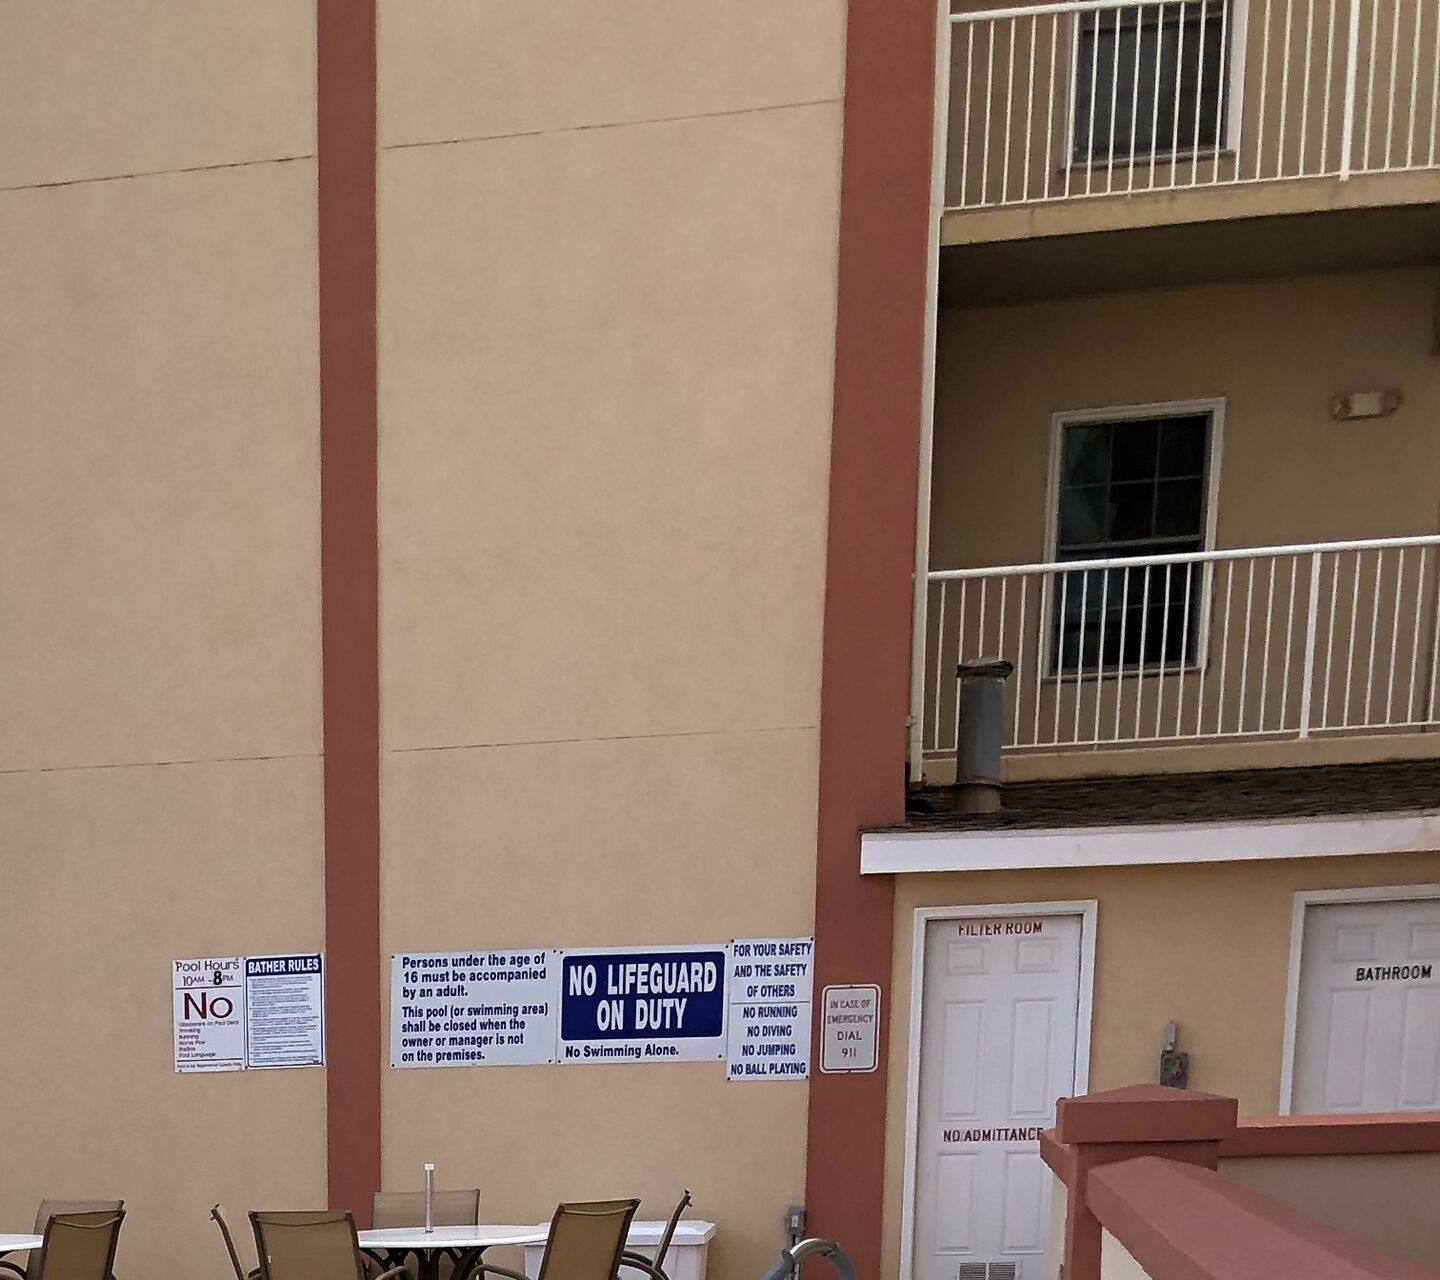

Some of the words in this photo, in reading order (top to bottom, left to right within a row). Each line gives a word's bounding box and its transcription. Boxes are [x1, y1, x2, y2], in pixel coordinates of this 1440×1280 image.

[1005, 921, 1043, 935] ROOM
[733, 944, 751, 957] FOR
[753, 943, 777, 957] YOUR
[779, 942, 812, 956] SAFETY
[175, 960, 201, 972] Pool
[204, 960, 240, 971] Hours
[248, 959, 286, 974] BATHER
[288, 958, 319, 972] RULES
[402, 956, 449, 969] Persons
[451, 953, 485, 968] under
[488, 953, 507, 966] the
[509, 955, 531, 968] age
[533, 951, 546, 965] of
[403, 970, 419, 984] 16
[421, 970, 450, 983] must
[452, 969, 467, 982] be
[469, 967, 547, 983] accompanied
[733, 964, 753, 978] AND
[755, 964, 772, 977] THE
[773, 963, 808, 977] SAFETY
[1355, 964, 1433, 982] BATHROOM
[569, 964, 597, 996] NO
[607, 961, 717, 995] LIFEGUARD
[402, 985, 417, 1001] by
[419, 988, 433, 998] an
[435, 984, 469, 997] adult.
[747, 985, 759, 998] OF
[760, 984, 795, 998] OTHERS
[183, 992, 234, 1020] No
[401, 1005, 424, 1018] This
[426, 1004, 448, 1020] pool
[450, 1004, 465, 1019] (or
[467, 1003, 519, 1018] swimming
[521, 1002, 548, 1017] area)
[830, 1000, 839, 1009] IN
[840, 1000, 860, 1009] CASE
[860, 999, 872, 1009] OF
[596, 999, 625, 1032] ON
[634, 998, 688, 1030] DUTY
[742, 1006, 756, 1019] NO
[757, 1005, 798, 1018] RUNNING
[827, 1014, 874, 1025] EMERGENCY
[401, 1020, 426, 1033] shall
[428, 1019, 441, 1032] be
[443, 1018, 477, 1032] closed
[479, 1018, 507, 1031] when
[509, 1017, 526, 1030] the
[747, 1025, 760, 1038] NO
[762, 1024, 792, 1037] DIVING
[401, 1037, 434, 1048] owner
[435, 1037, 447, 1047] or
[448, 1035, 494, 1049] manager
[495, 1032, 505, 1046] is
[507, 1032, 524, 1045] not
[836, 1030, 863, 1041] DIAL
[401, 1052, 415, 1063] on
[416, 1049, 433, 1062] the
[435, 1048, 485, 1064] premises.
[565, 1045, 581, 1058] No
[583, 1044, 642, 1059] Swimming
[644, 1043, 680, 1057] Alone.
[741, 1044, 755, 1057] NO
[756, 1043, 796, 1056] JUMPING
[841, 1047, 857, 1058] 911
[730, 1063, 744, 1075] NO
[745, 1062, 767, 1075] BALL
[769, 1062, 807, 1075] PLAYING
[943, 1129, 961, 1142] NO
